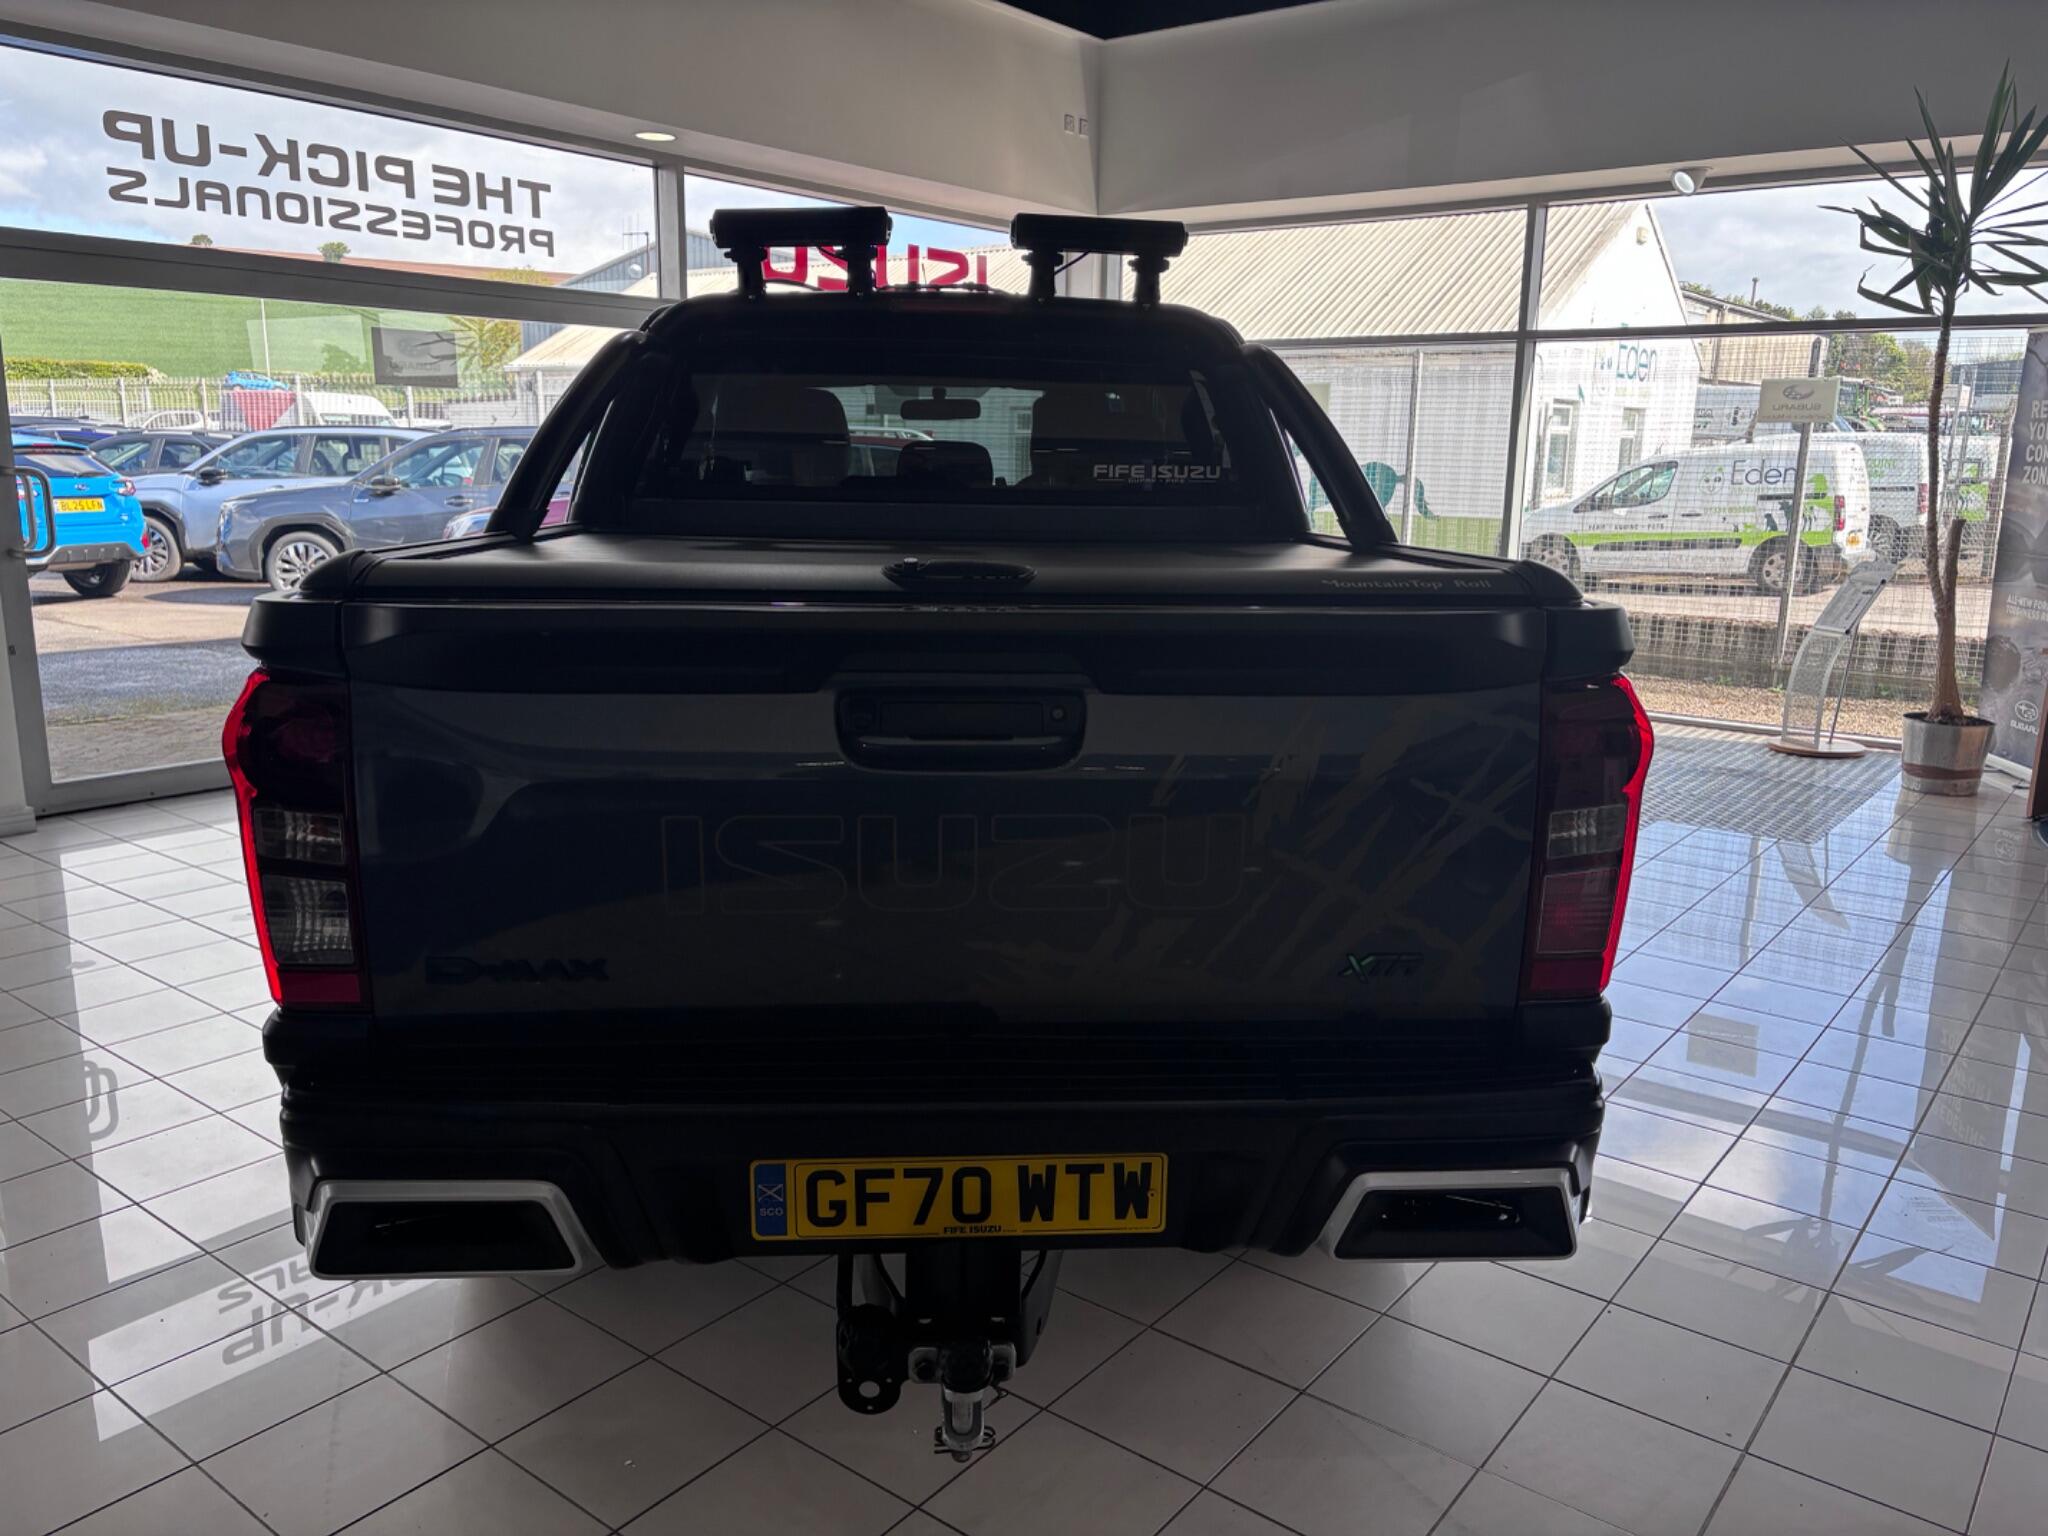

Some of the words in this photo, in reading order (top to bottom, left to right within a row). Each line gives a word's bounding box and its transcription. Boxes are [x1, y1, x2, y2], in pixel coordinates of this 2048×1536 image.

[1093, 464, 1146, 479] FIFE
[1151, 464, 1222, 479] ISUZU
[1321, 578, 1443, 591] MountainTop
[660, 813, 1250, 912] ISUZU
[425, 954, 610, 984] D-MAX
[805, 1165, 993, 1228] GF70
[1017, 1161, 1154, 1222] WTW
[759, 1206, 785, 1217] SCO
[968, 1224, 1003, 1234] ISUZU
